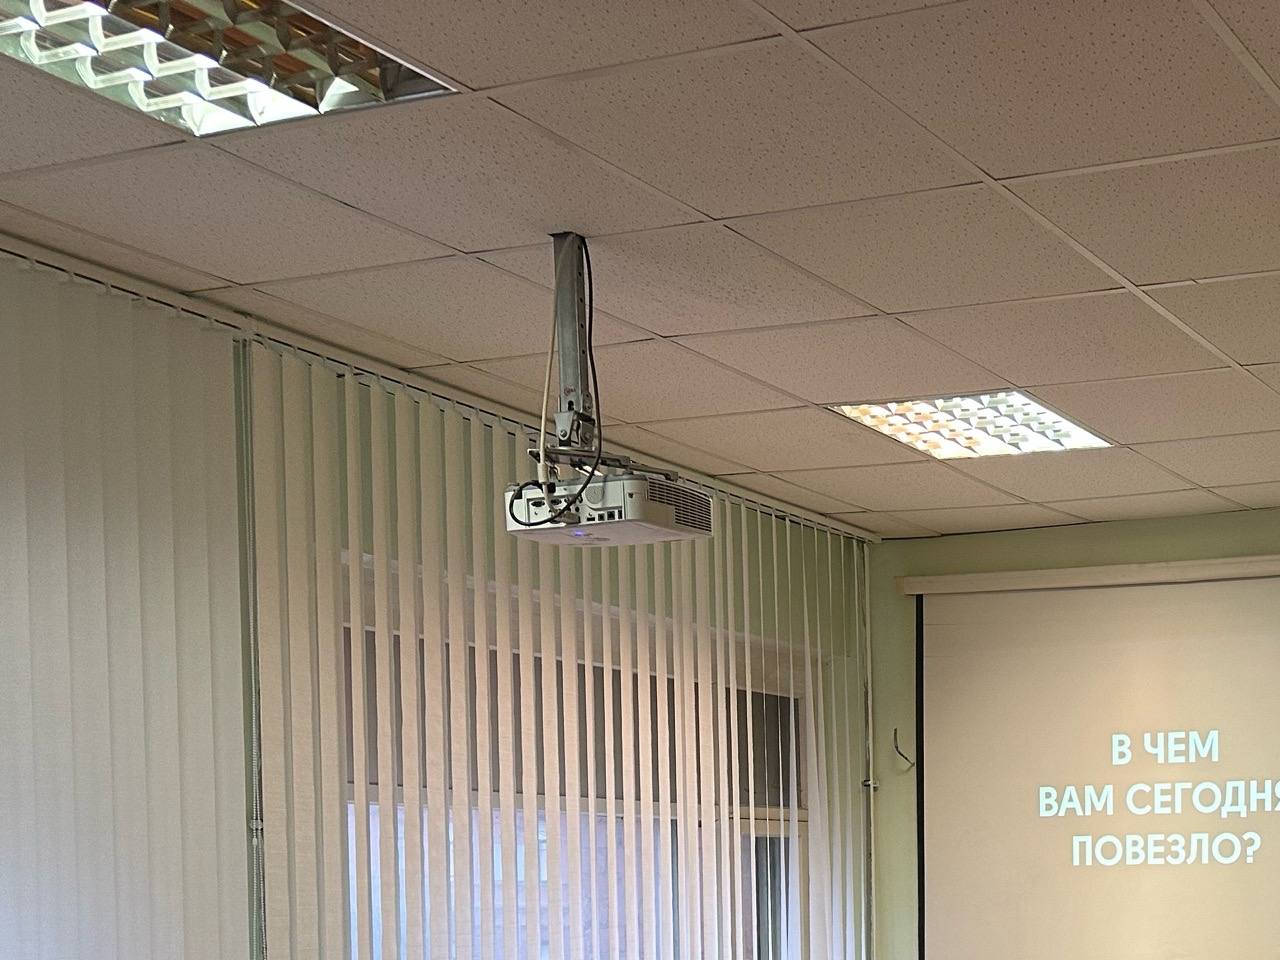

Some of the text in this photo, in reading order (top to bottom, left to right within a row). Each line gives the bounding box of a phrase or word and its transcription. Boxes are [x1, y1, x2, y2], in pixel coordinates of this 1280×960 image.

[1111, 730, 1220, 765] В ЧЕМ
[1039, 784, 1114, 817] ВАМ
[1071, 831, 1262, 866] ПОВЕЗЛО?
